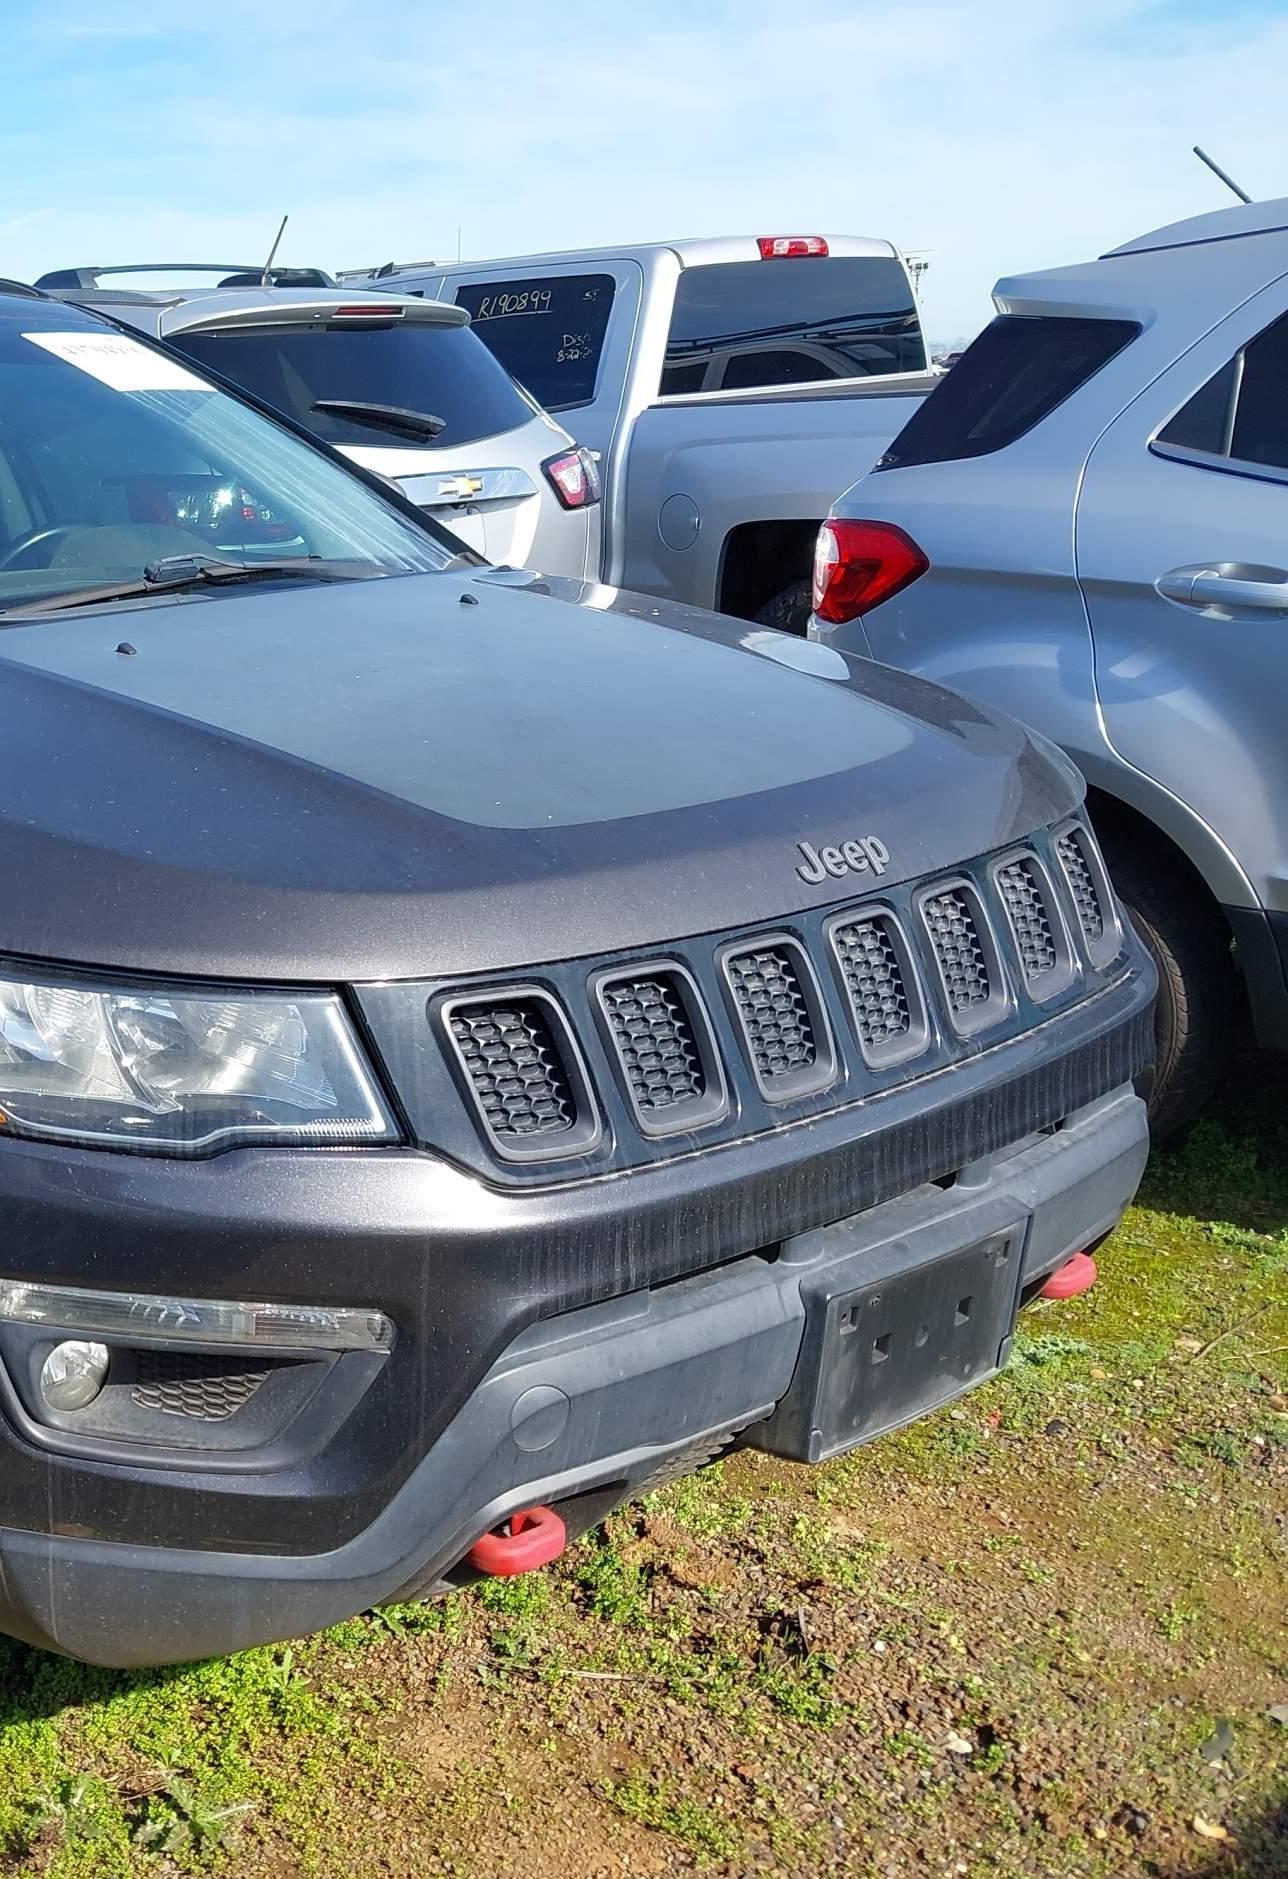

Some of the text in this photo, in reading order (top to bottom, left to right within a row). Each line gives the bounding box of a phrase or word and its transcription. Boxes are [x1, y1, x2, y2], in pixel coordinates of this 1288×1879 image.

[477, 289, 553, 319] R190899
[556, 346, 593, 363] 8-22-2
[795, 835, 891, 886] Jeep
